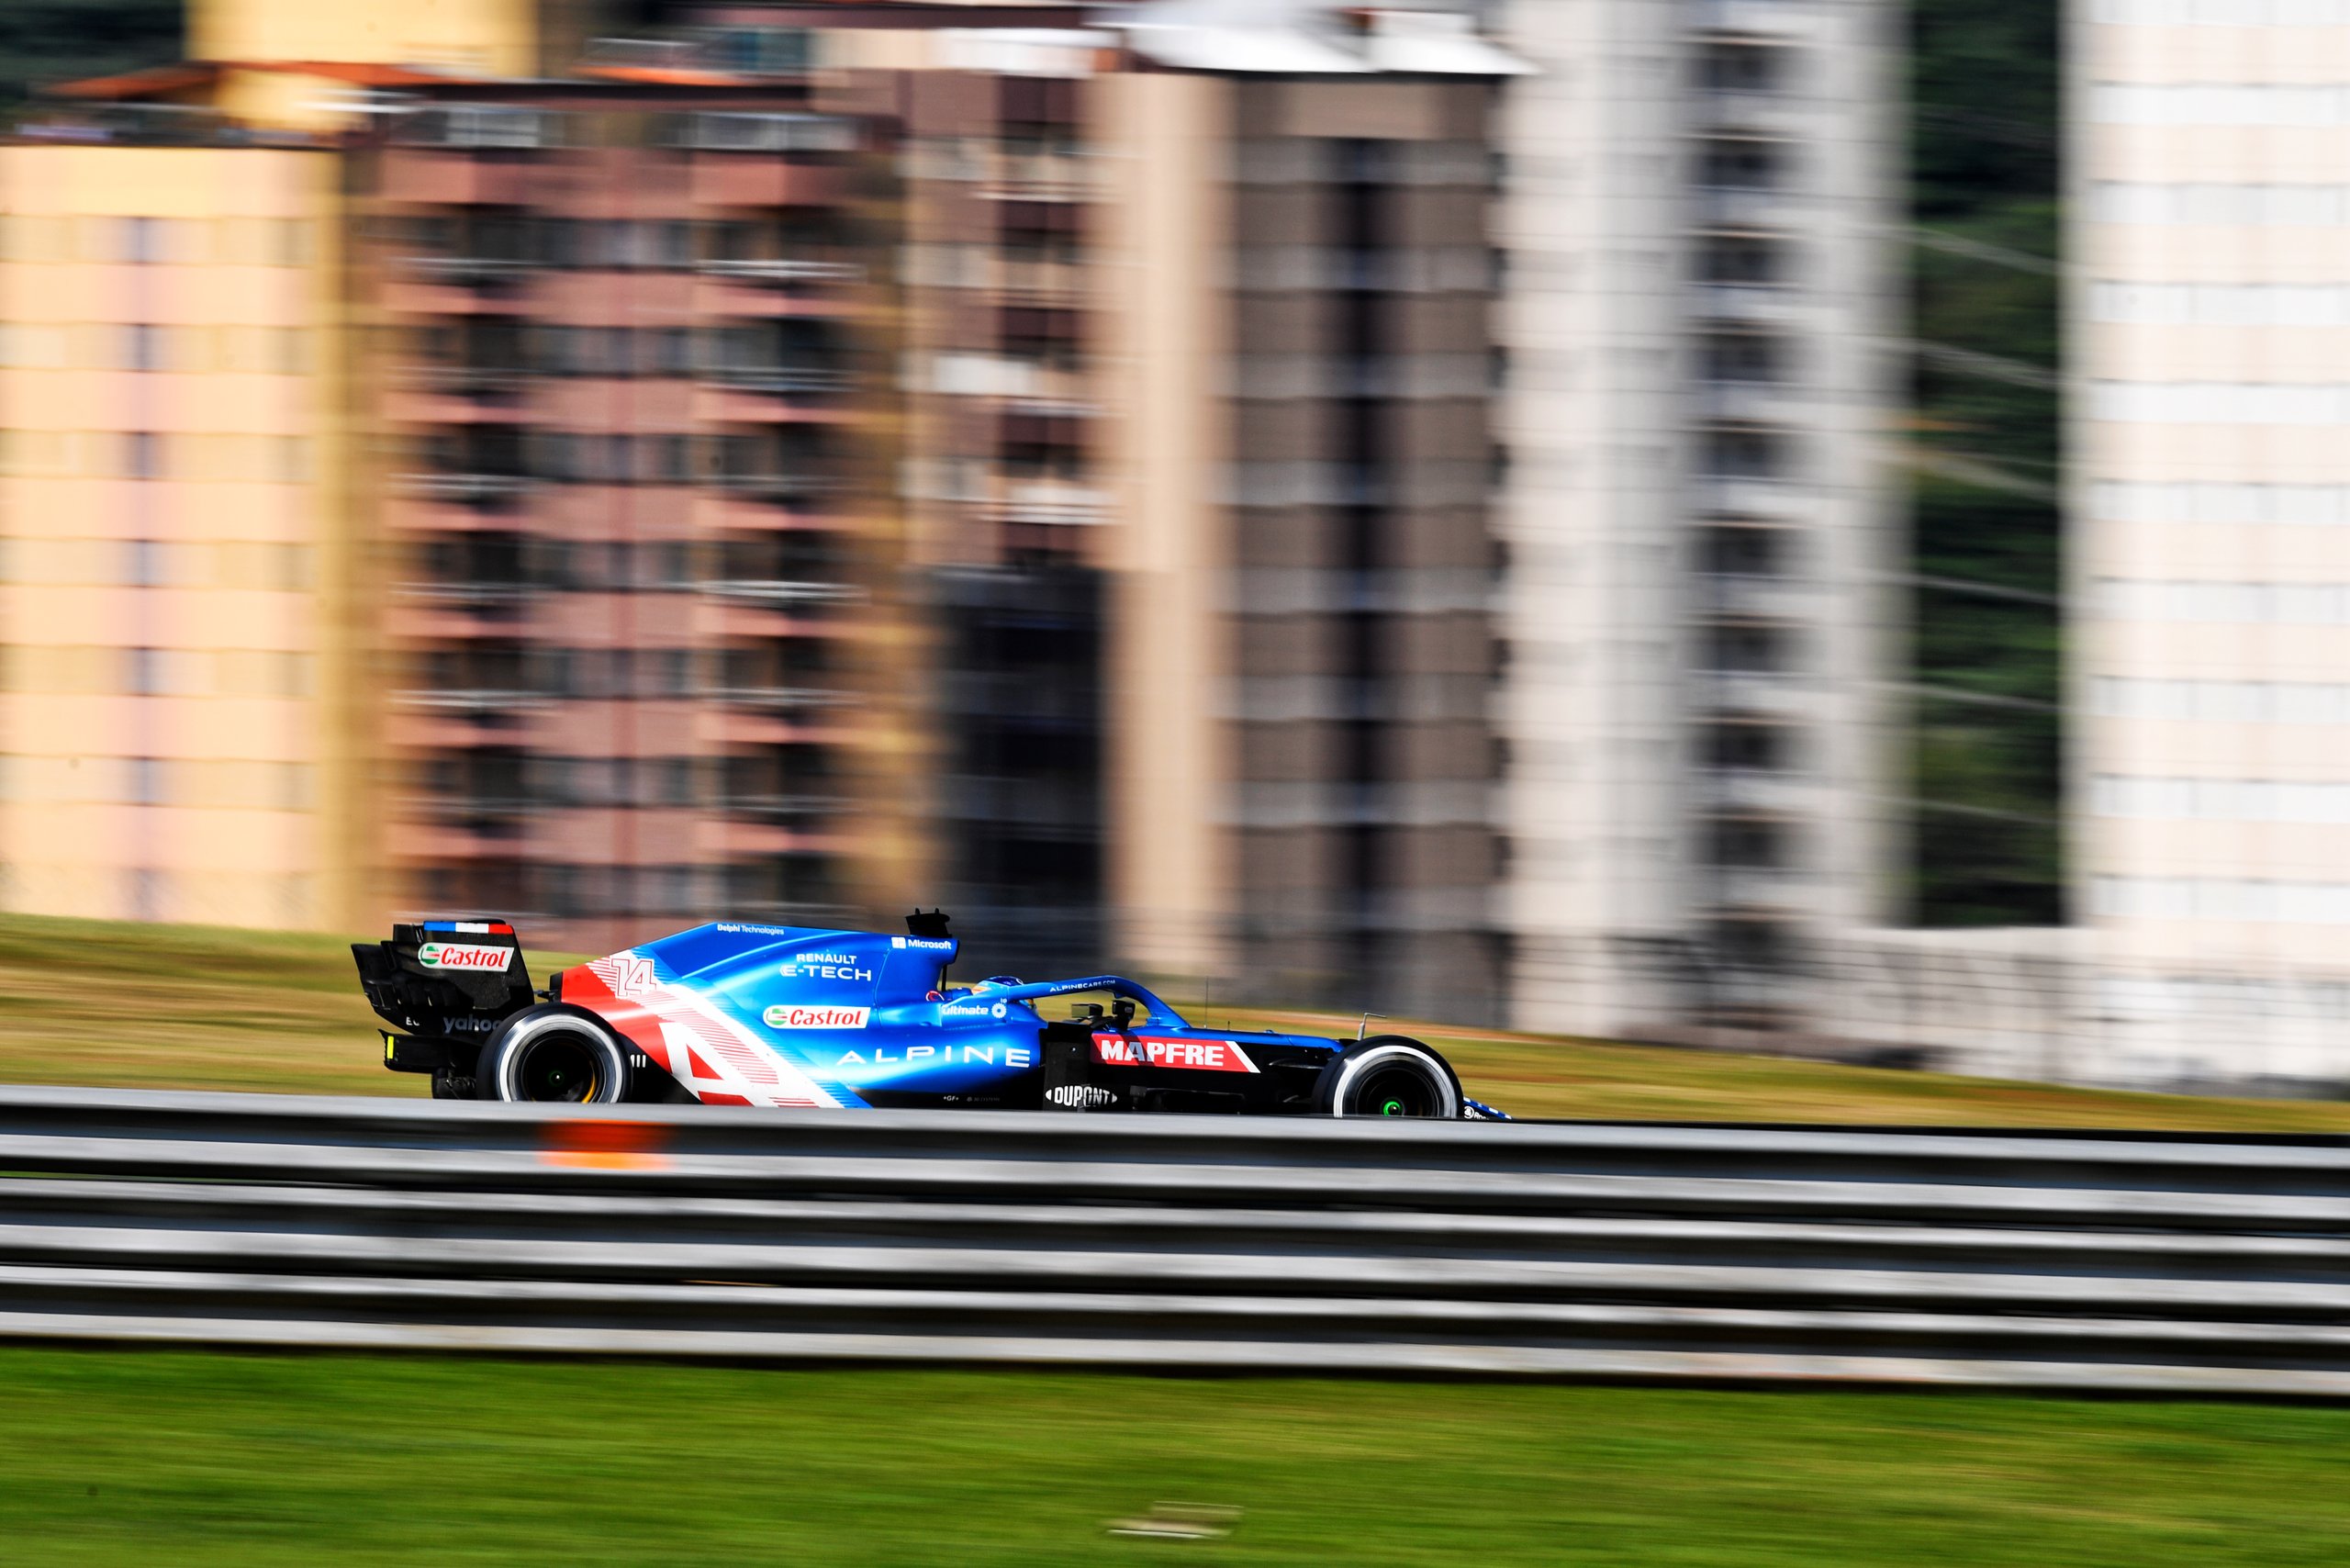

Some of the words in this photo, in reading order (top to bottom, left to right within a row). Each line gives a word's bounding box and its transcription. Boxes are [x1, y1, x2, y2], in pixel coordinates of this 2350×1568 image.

[718, 924, 740, 933] Delphi
[742, 925, 784, 935] Technologies
[908, 939, 952, 949] Microsoft
[441, 946, 506, 968] Castrol
[796, 953, 857, 965] RENAULT
[610, 958, 657, 998] 14
[779, 965, 872, 981] E-TECH
[789, 1009, 862, 1026] Castrol
[942, 1004, 989, 1015] ultimate
[836, 1045, 1031, 1069] ALPINE
[1101, 1039, 1225, 1067] MAPFRE
